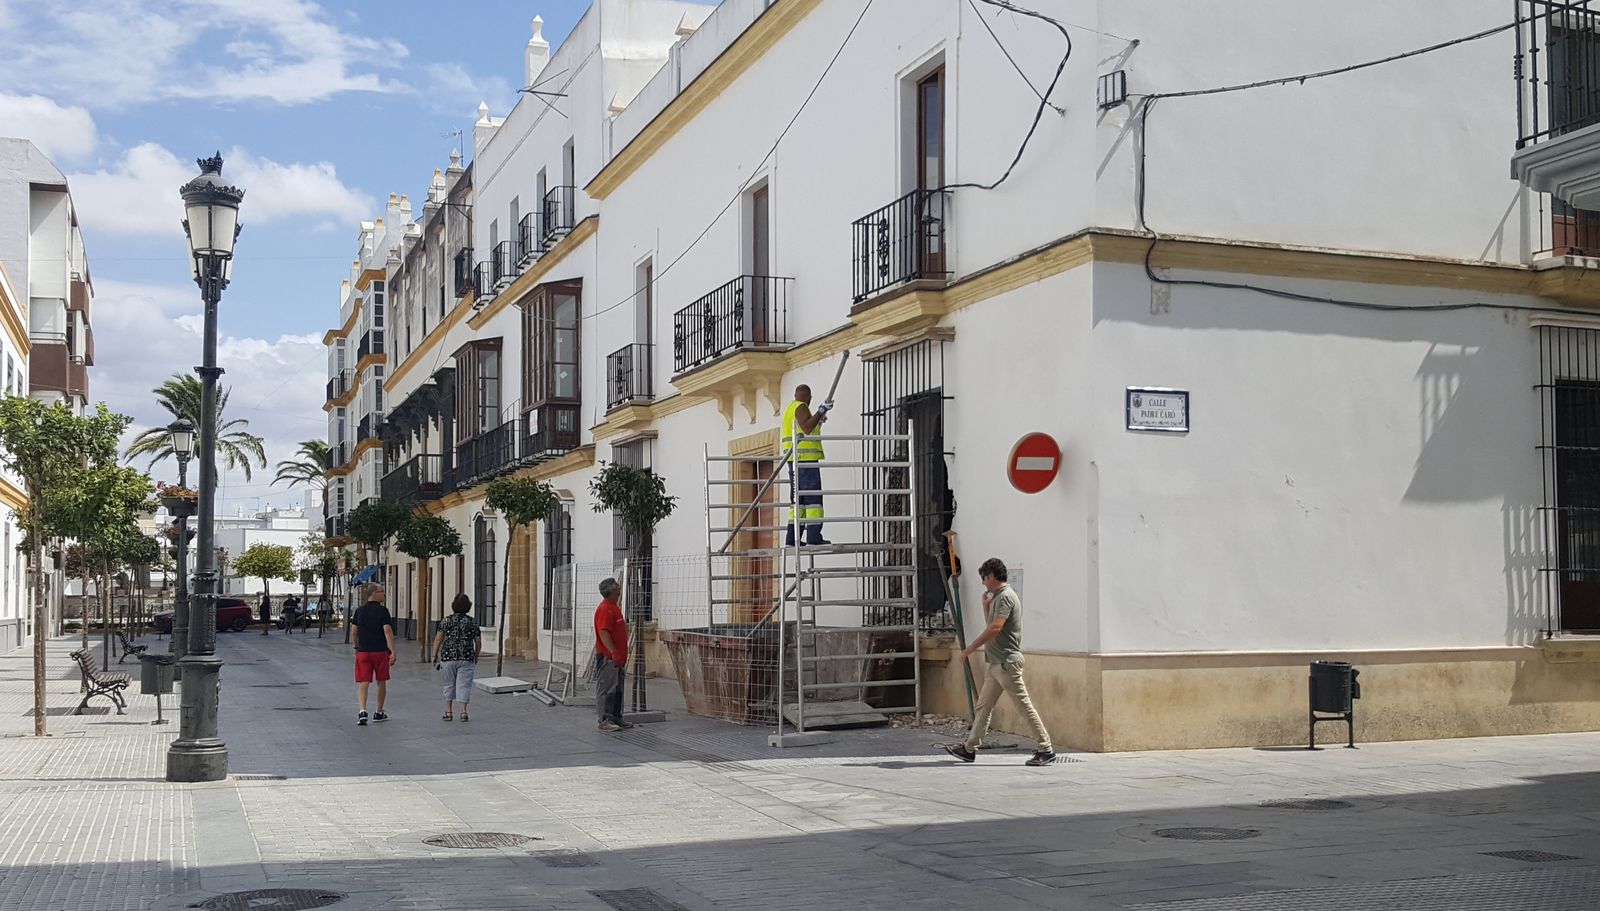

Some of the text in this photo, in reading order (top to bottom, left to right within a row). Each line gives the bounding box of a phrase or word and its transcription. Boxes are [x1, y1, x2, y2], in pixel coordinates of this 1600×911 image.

[1149, 399, 1167, 407] CALLE
[1141, 410, 1176, 419] PADRE CARO
